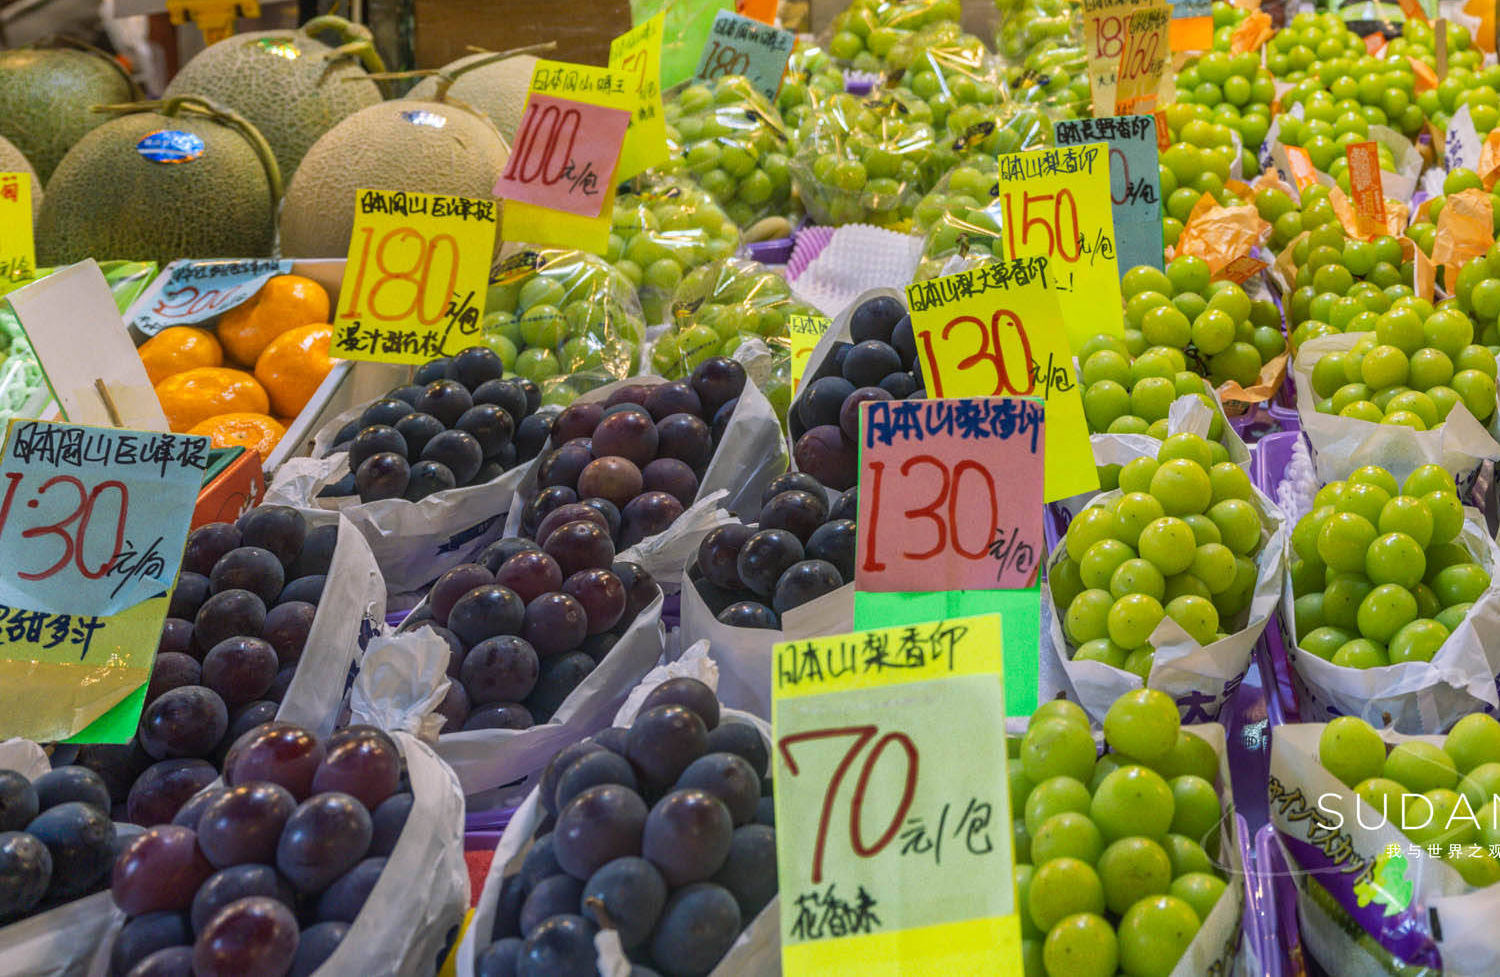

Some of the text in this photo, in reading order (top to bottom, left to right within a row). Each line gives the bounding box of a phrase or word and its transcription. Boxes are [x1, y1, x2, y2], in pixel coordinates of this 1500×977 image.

[503, 103, 582, 186] 100
[1003, 187, 1082, 263] 150
[339, 226, 460, 326] 180
[917, 308, 1037, 399] 130
[862, 454, 998, 572] 130
[777, 622, 969, 689] 日本山梨香印
[777, 724, 920, 885] 70
